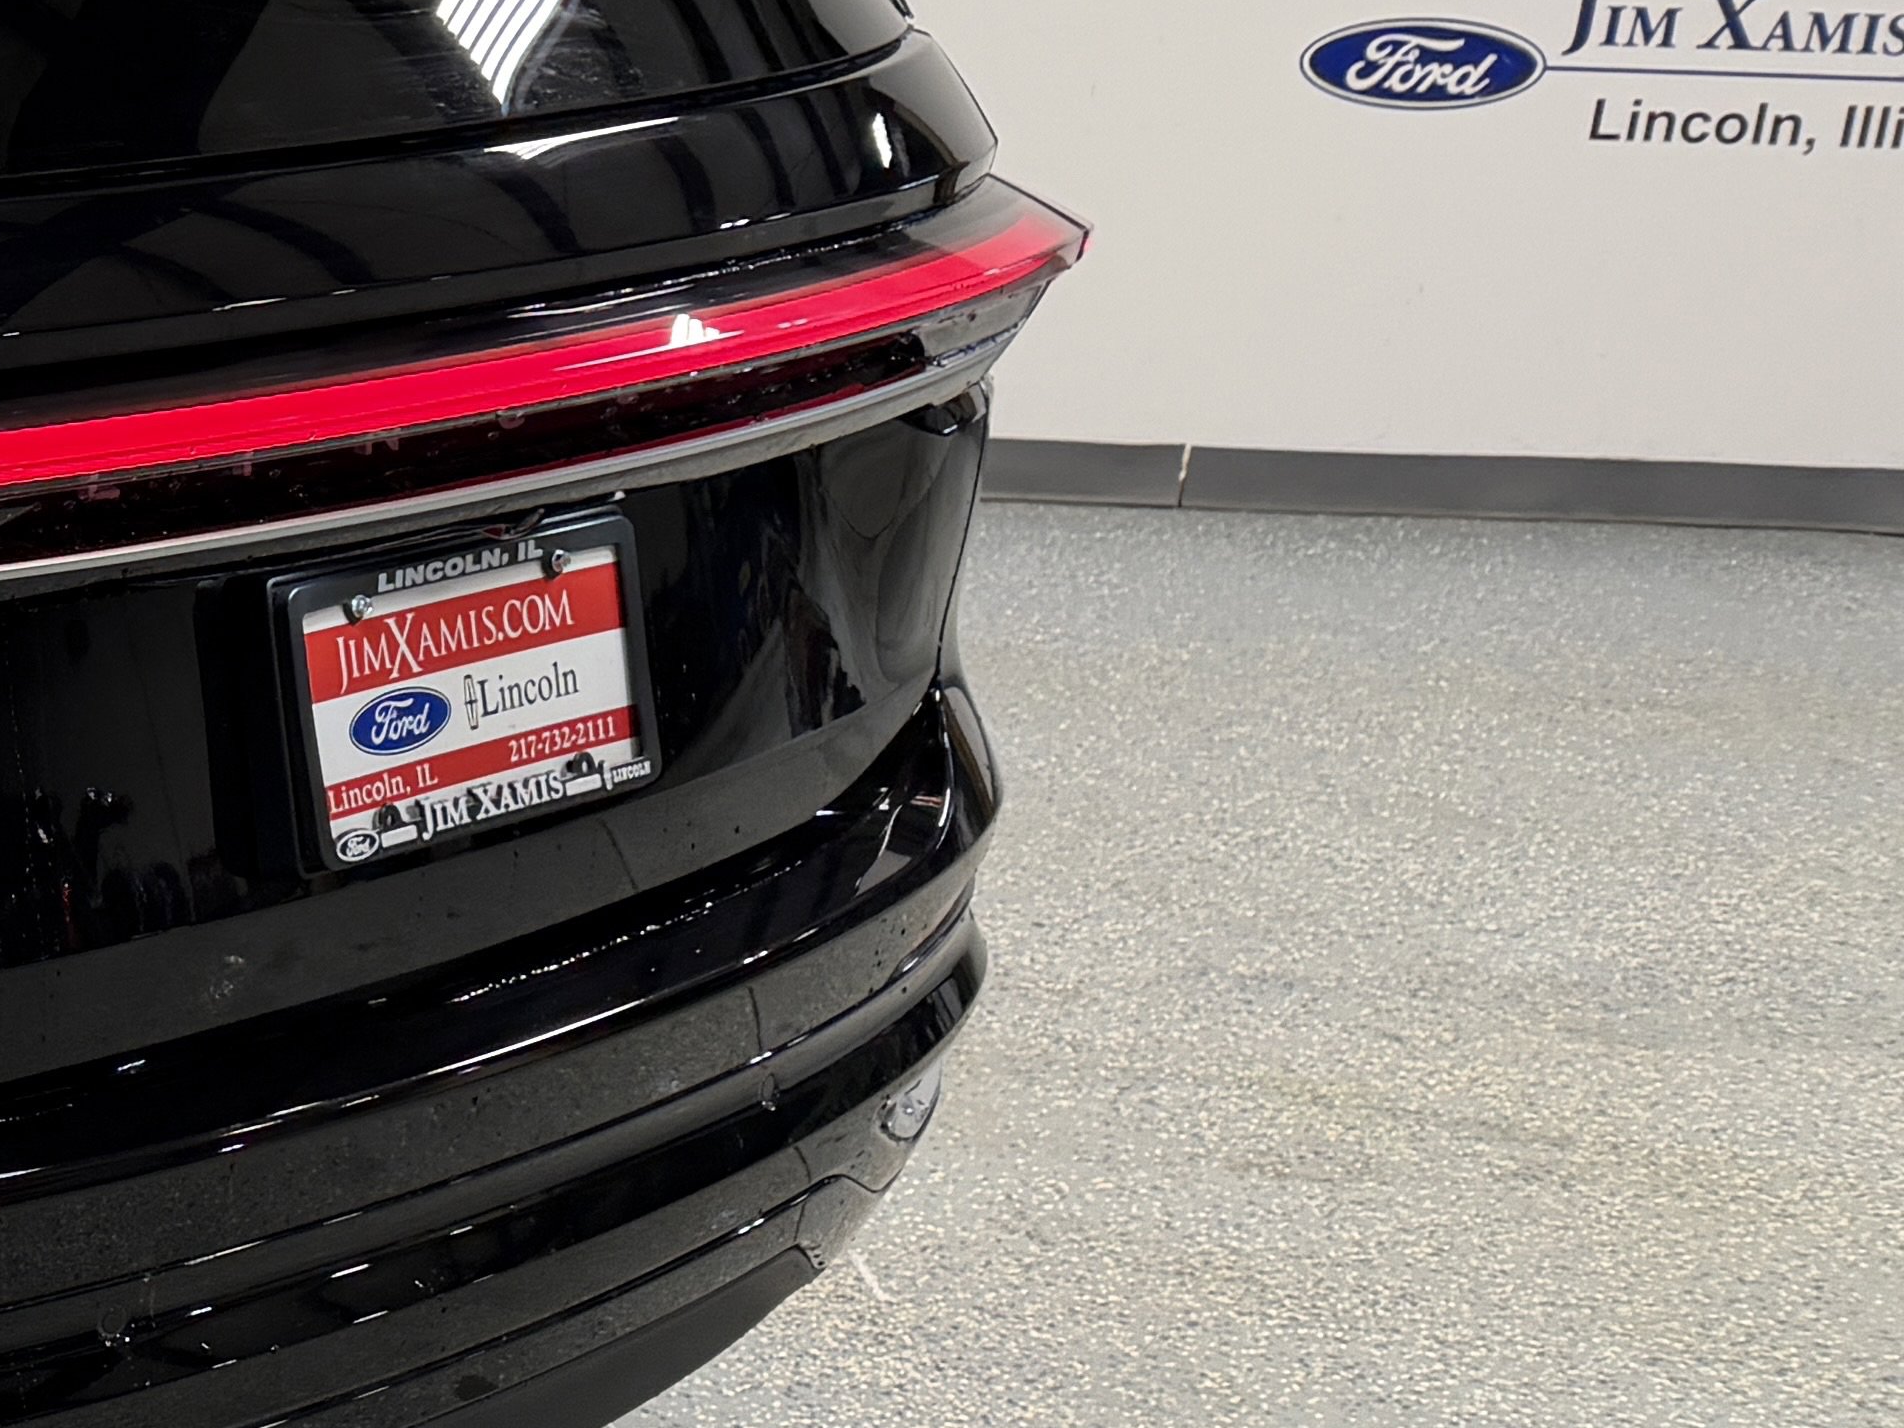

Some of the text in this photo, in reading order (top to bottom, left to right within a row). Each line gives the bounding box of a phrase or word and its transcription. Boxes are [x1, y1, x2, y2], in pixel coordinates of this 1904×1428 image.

[1343, 32, 1500, 97] Ford
[1588, 98, 1816, 156] Lincoln,
[377, 539, 545, 593] LINCOLN, IL
[334, 588, 575, 695] JIMXAMIS.COM
[479, 661, 580, 718] Lincoln
[370, 696, 431, 747] Ford
[506, 715, 617, 764] 217-732-2111
[328, 764, 439, 815] Lincoln, IL
[422, 770, 566, 840] JIM XAMIS
